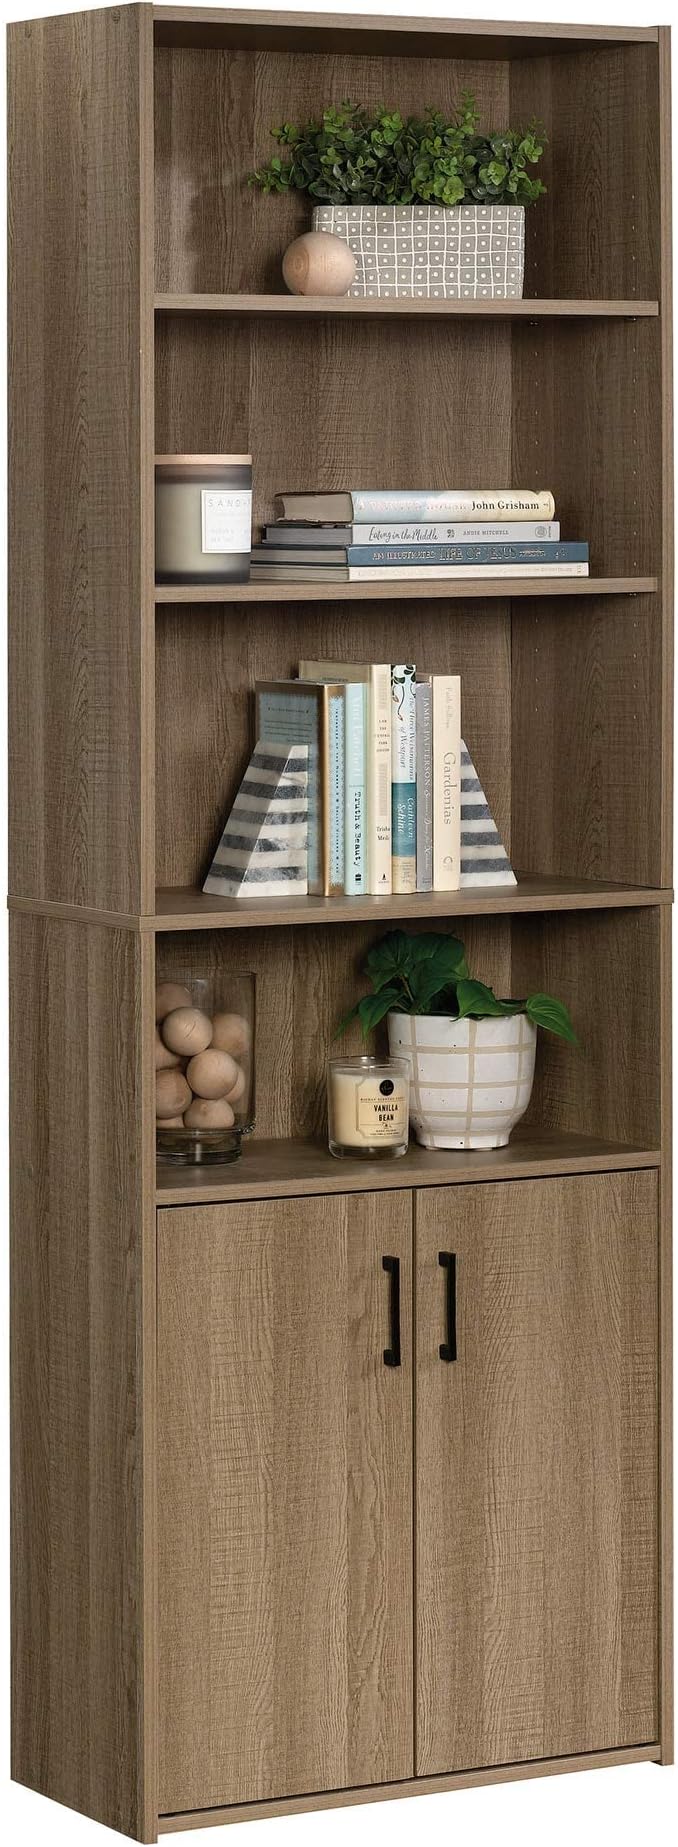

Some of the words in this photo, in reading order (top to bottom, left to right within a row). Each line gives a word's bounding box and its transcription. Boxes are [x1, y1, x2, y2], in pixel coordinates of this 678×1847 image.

[471, 501, 495, 511] John
[497, 500, 539, 510] Grisham
[412, 527, 439, 542] Middle
[423, 730, 431, 787] PATTERSON
[443, 752, 457, 825] Gardenias
[354, 791, 362, 821] Truth
[353, 832, 362, 867] Beauty
[373, 1104, 399, 1112] VANILLA
